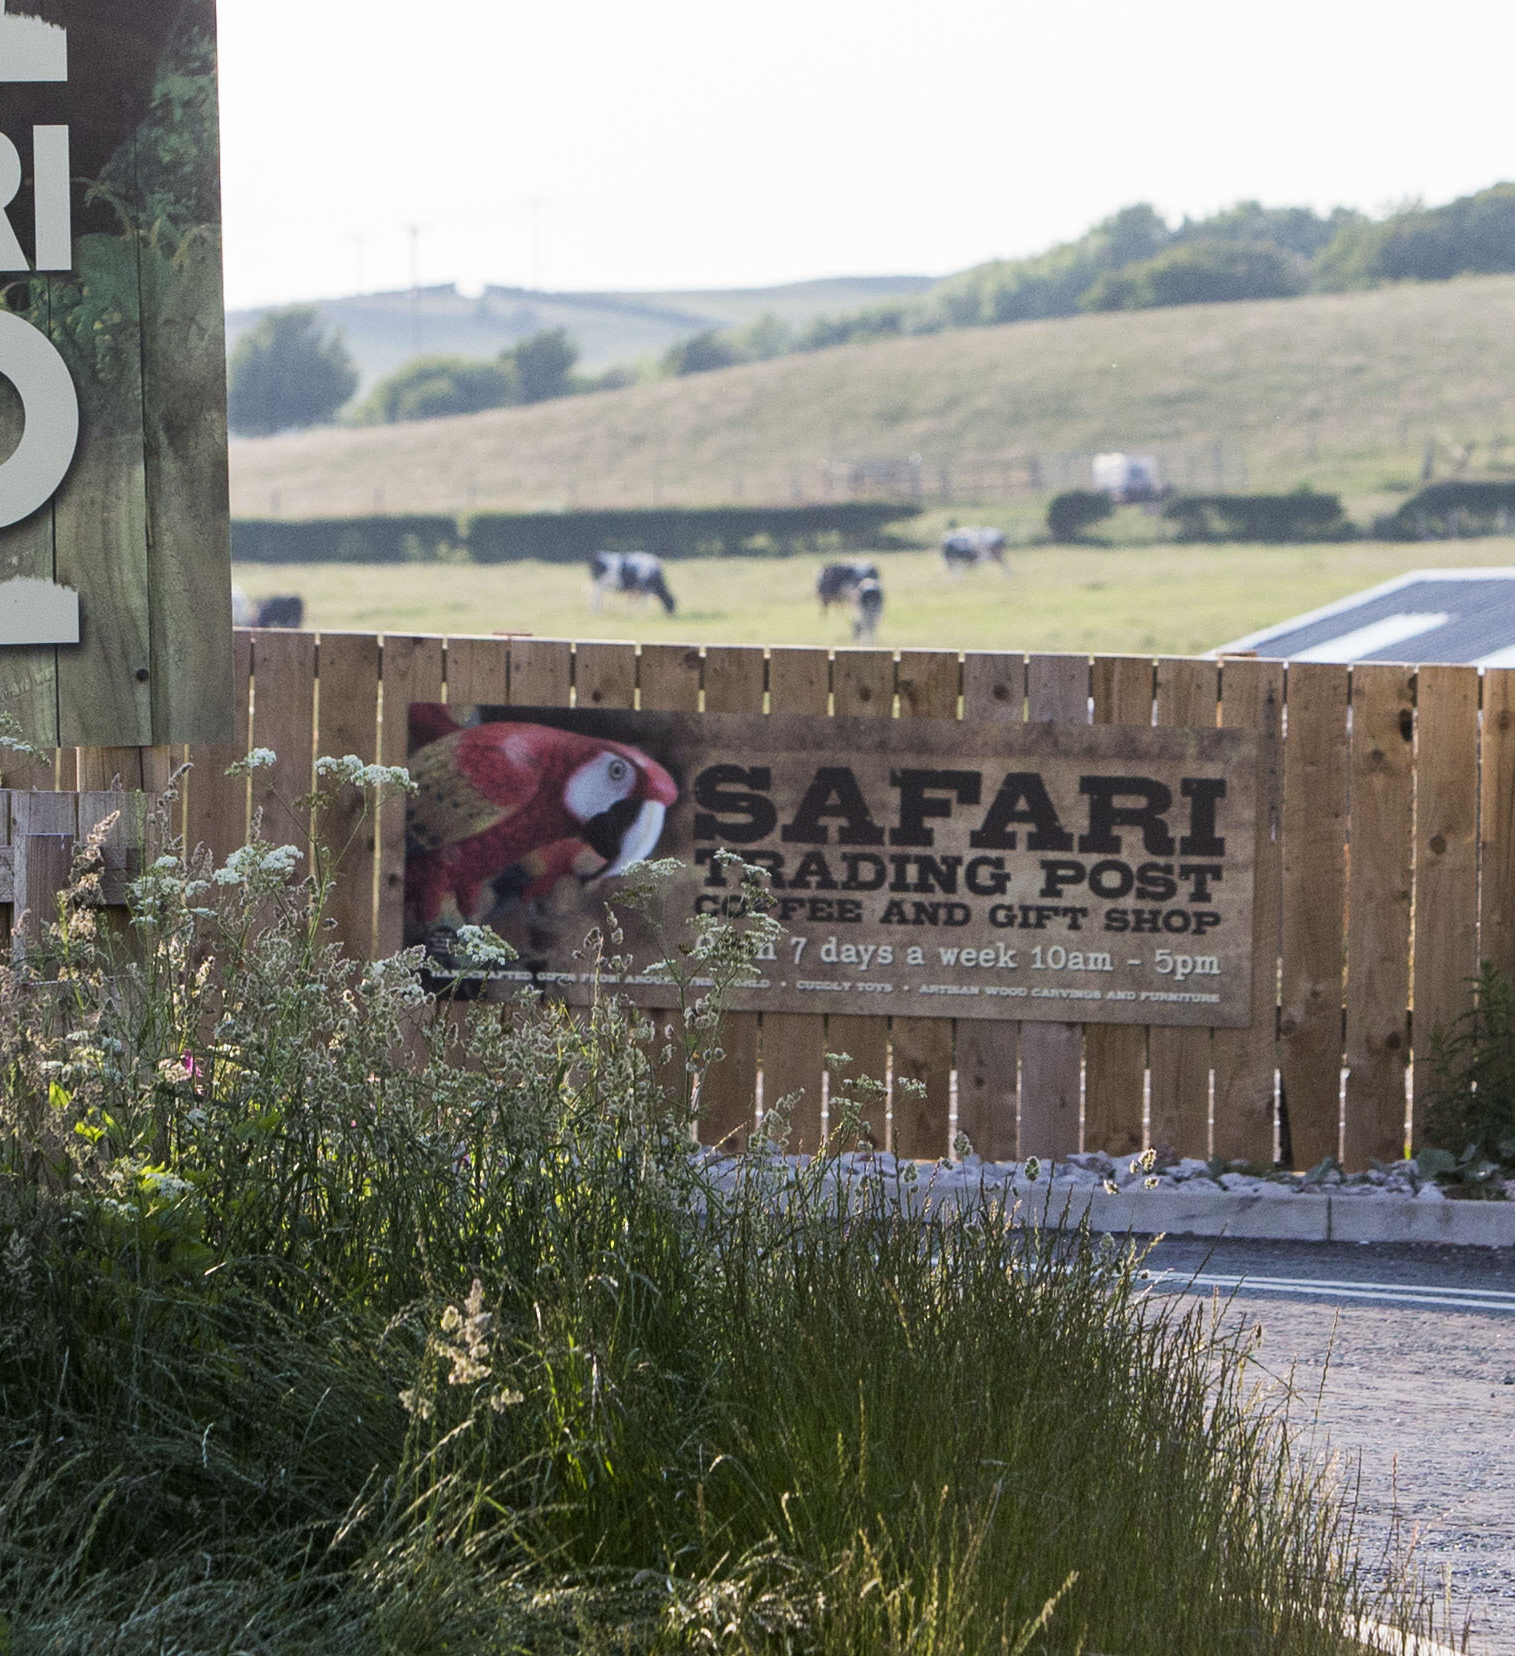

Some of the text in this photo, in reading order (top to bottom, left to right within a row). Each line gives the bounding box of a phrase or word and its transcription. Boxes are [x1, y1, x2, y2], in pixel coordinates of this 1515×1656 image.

[693, 763, 1227, 857] SAFARI
[694, 847, 1223, 904] TRADING POST
[694, 893, 1222, 935] COFEE AND GIFT SHOP
[789, 936, 808, 965] 7
[820, 936, 895, 971] days
[906, 945, 926, 965] a
[940, 942, 1018, 969] week
[1030, 945, 1114, 972] 10am
[1153, 948, 1222, 981] 5pm
[984, 986, 1028, 997] WOOD
[1031, 988, 1102, 1000] CARVINGS
[1106, 991, 1136, 1002] AND
[1139, 992, 1221, 1004] FURNITURE
